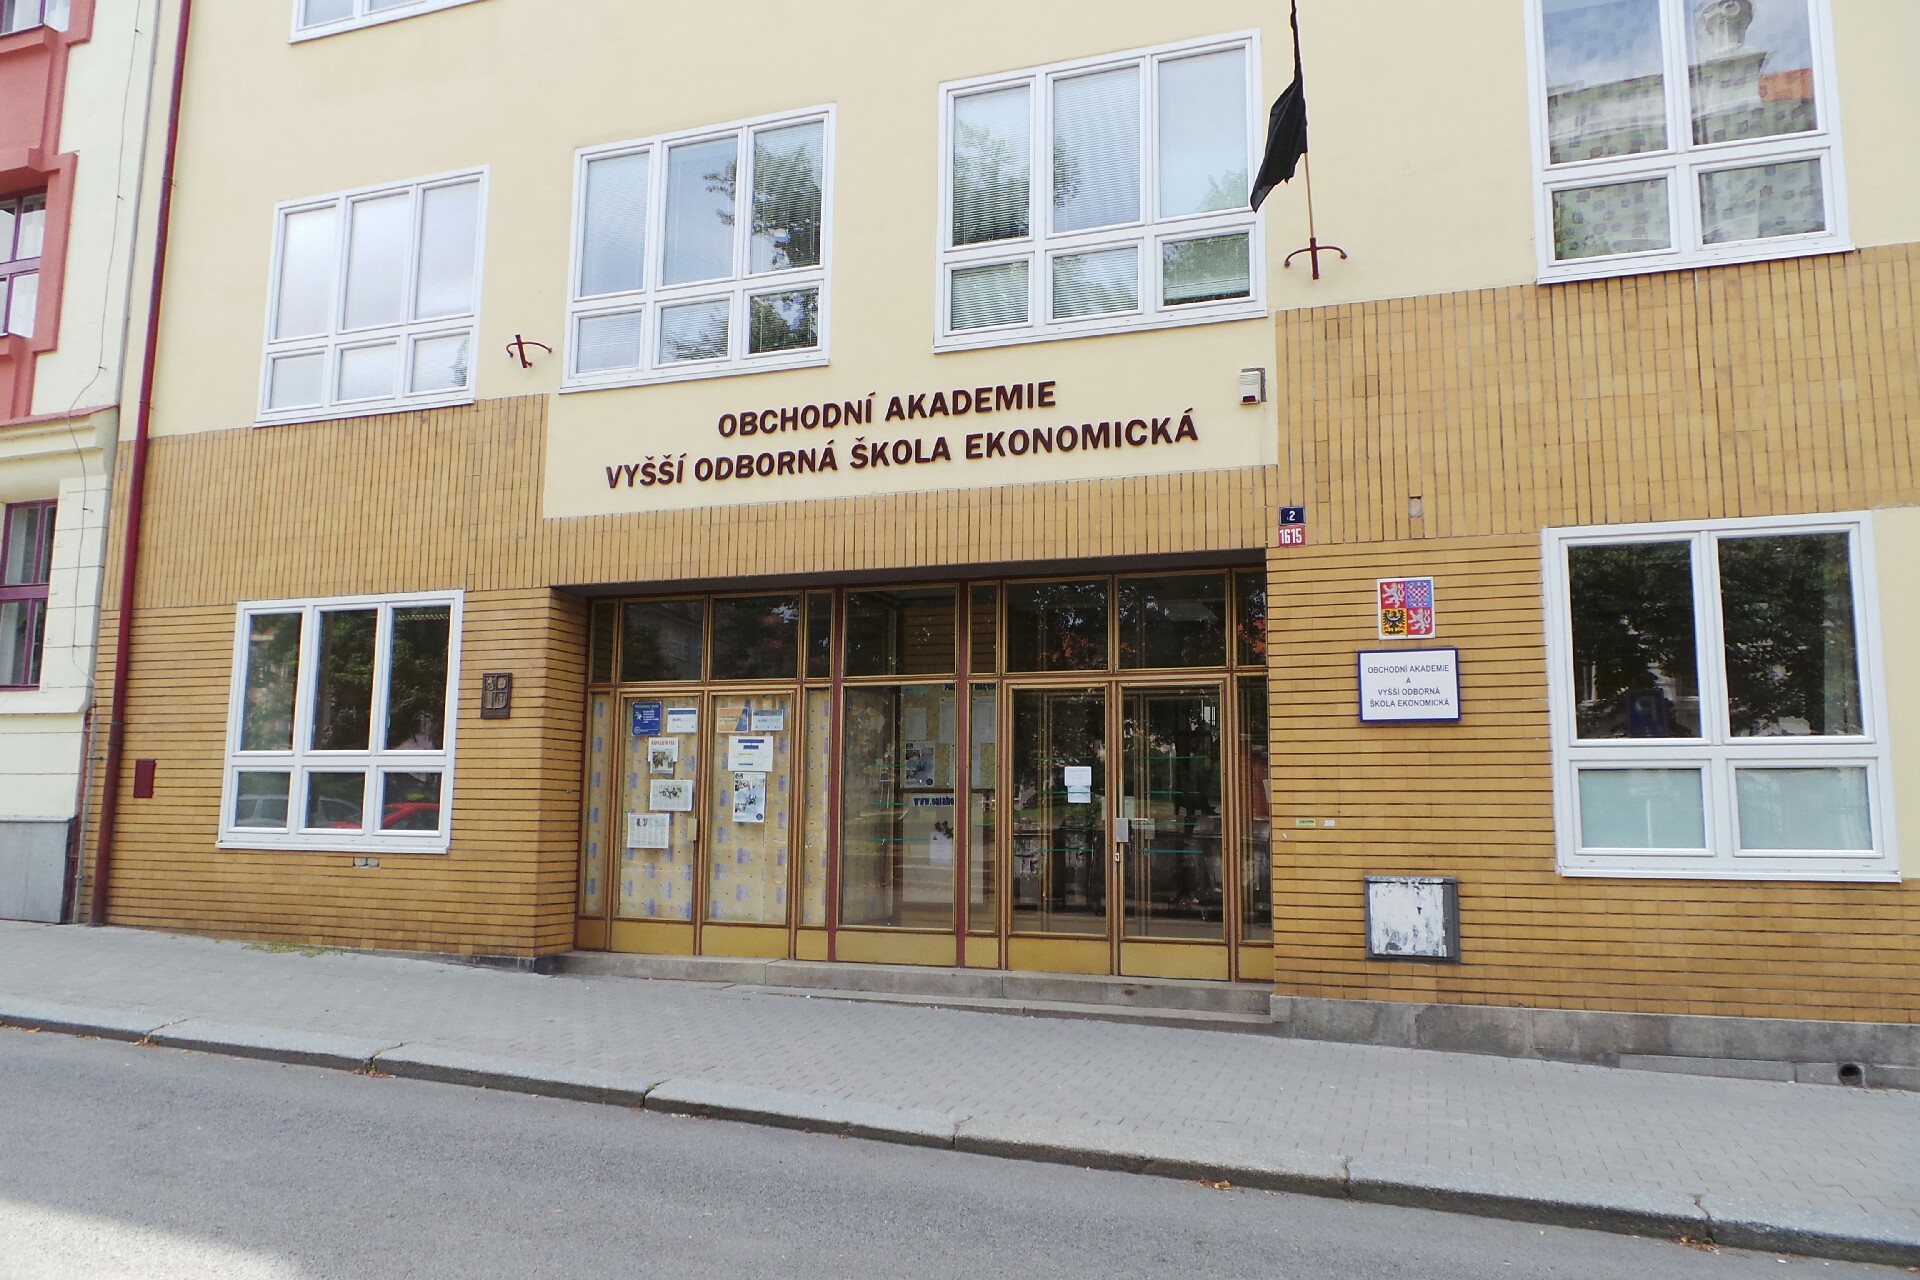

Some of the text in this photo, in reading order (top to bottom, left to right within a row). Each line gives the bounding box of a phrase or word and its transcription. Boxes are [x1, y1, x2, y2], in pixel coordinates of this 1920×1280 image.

[719, 381, 1056, 438] OBCHODNÍ AKADEMIE
[606, 408, 1199, 489] VYŠŠÍ ODBORNÁ ŠKOLA EKONOMICKÁ
[1289, 510, 1296, 521] 2
[1279, 528, 1303, 544] 1615
[1368, 664, 1450, 674] OBCHODNÍ AKADEMIE
[1378, 686, 1441, 696] VYŠŠÍ ODBORNÁ
[1369, 697, 1450, 708] ŠKOLA EKONOMICKÁ
